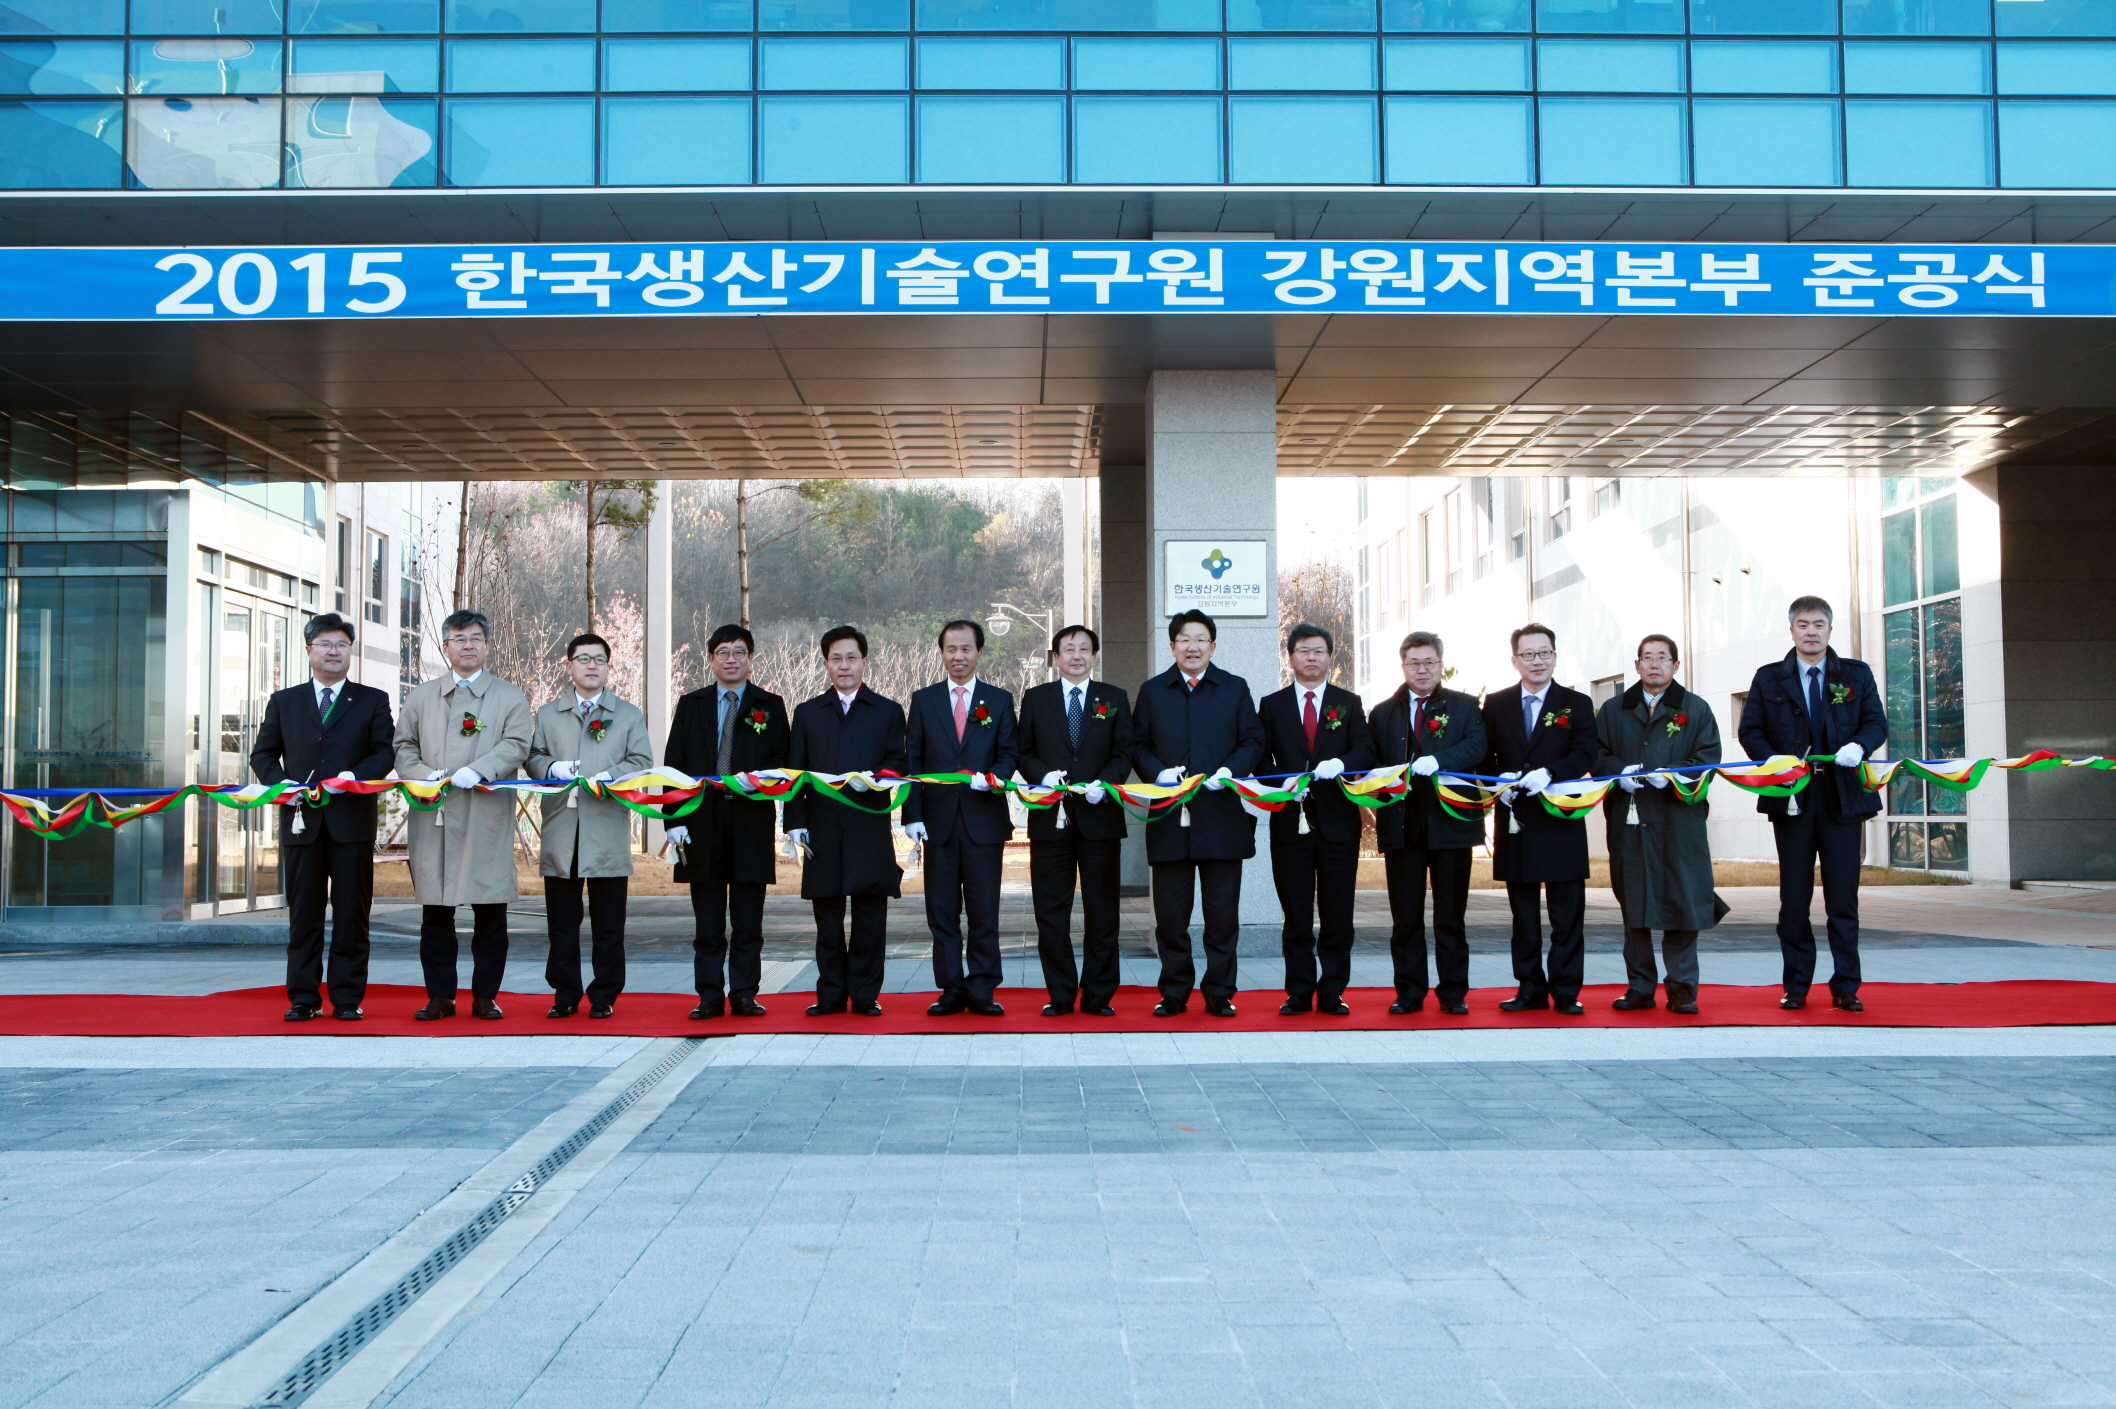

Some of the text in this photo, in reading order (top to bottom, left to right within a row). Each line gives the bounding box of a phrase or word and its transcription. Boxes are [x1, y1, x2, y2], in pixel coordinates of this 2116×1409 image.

[154, 247, 2046, 315] 2015 한국생산기술연구원 강원지역본부 준공식
[1174, 584, 1260, 594] 한국생산기술연구원
